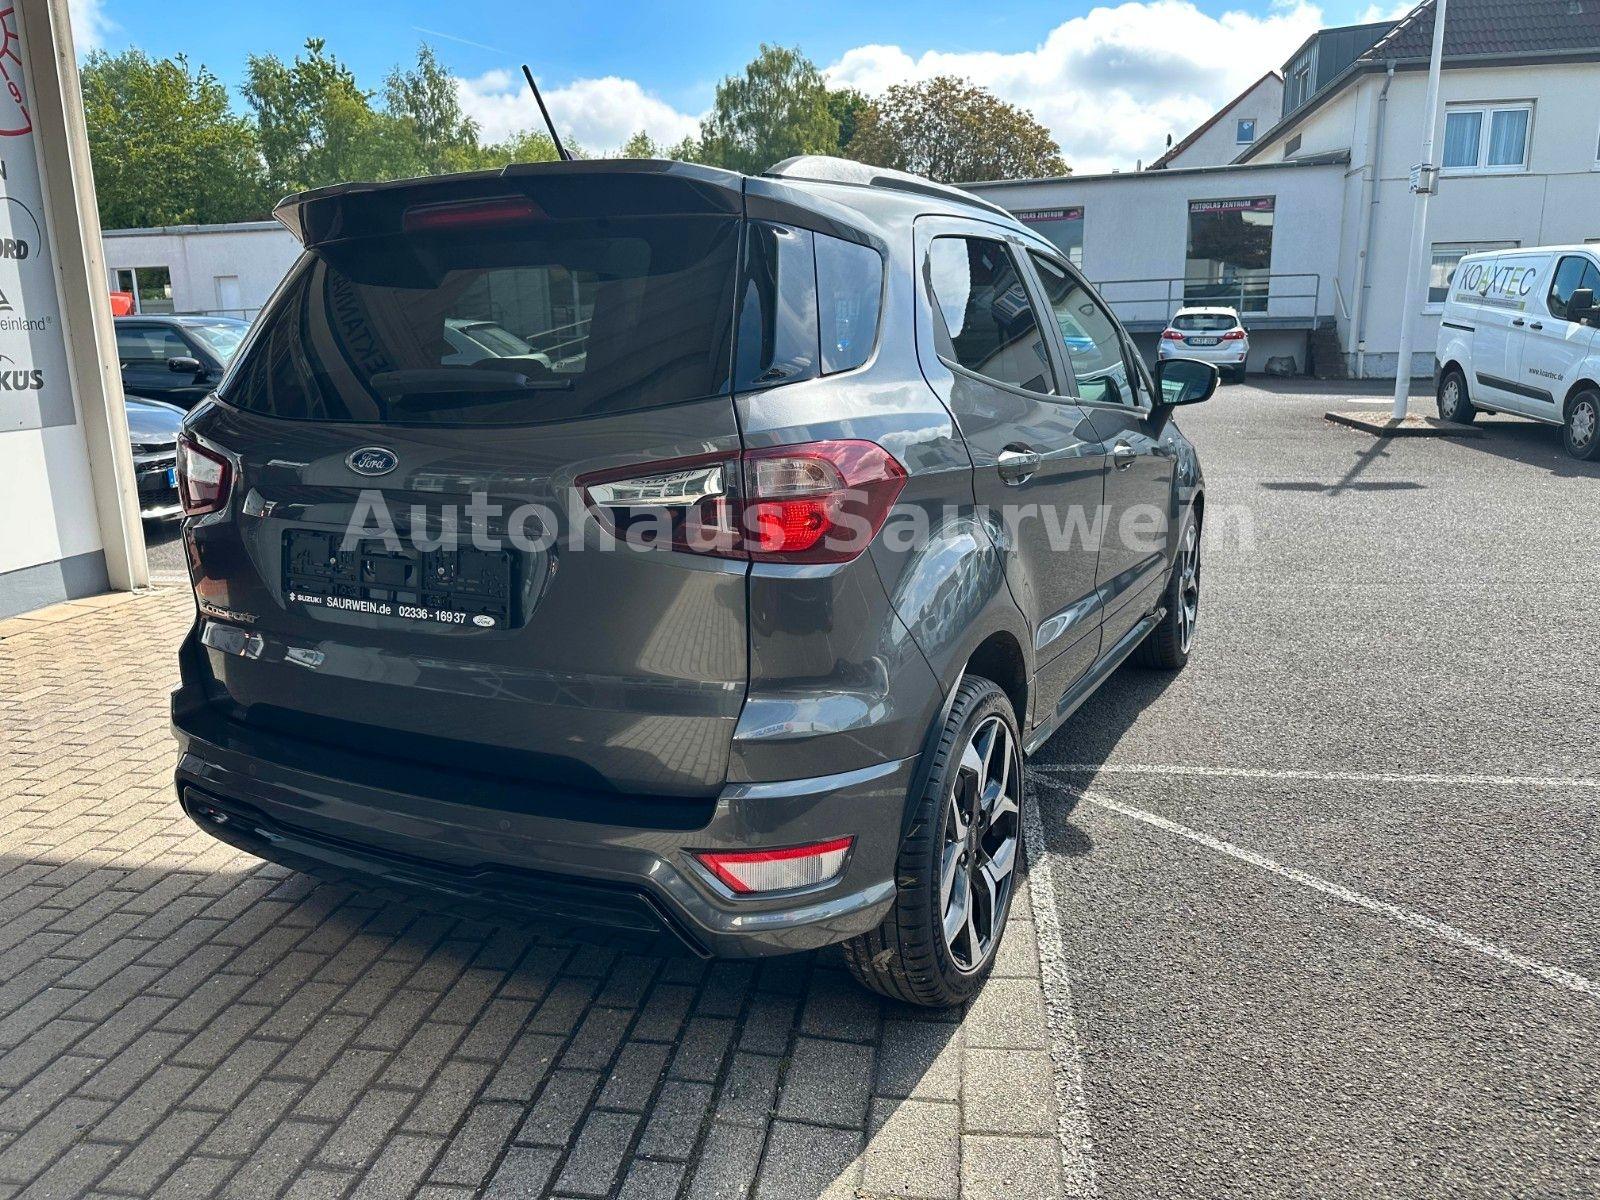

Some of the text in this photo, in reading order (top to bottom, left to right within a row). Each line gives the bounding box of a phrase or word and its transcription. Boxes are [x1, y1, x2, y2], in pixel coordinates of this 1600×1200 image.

[1190, 201, 1221, 210] AUTOGLAS
[1222, 200, 1251, 209] ZENTRUM
[1459, 264, 1537, 297] KOAXTEC
[297, 594, 322, 604] SUZUKI
[326, 596, 391, 615] SAURWEIN.de
[398, 605, 428, 620] 02336
